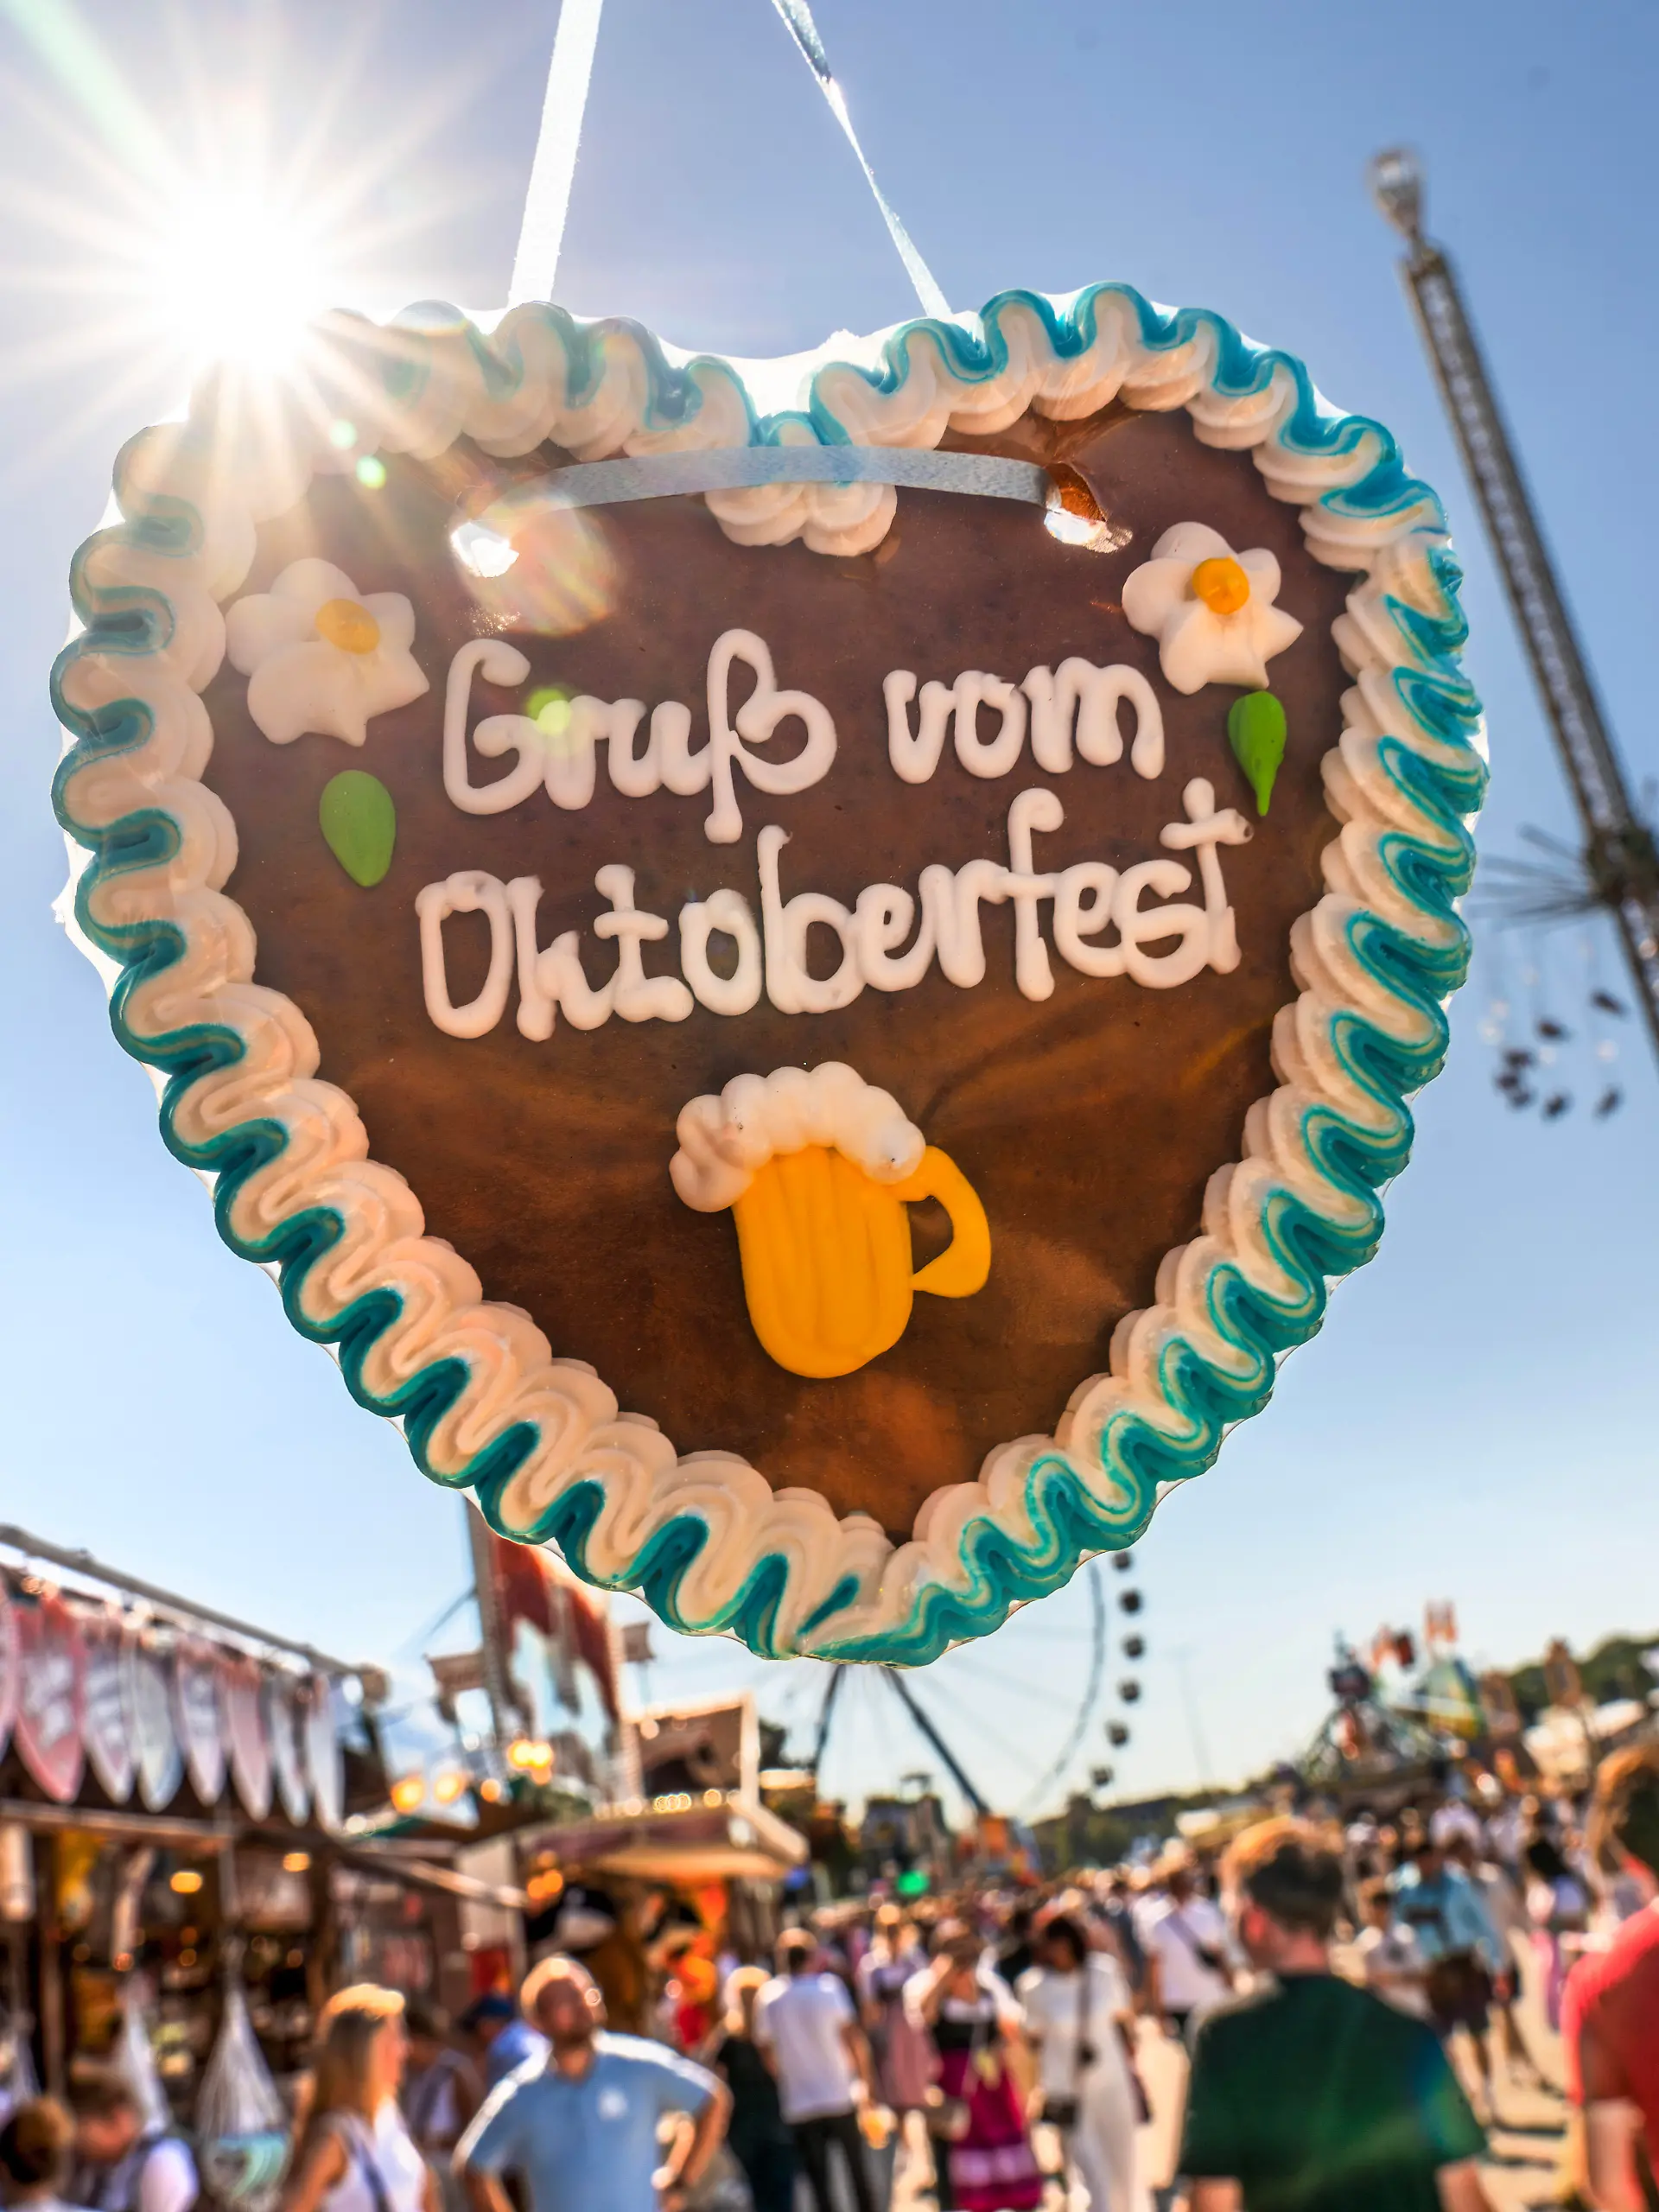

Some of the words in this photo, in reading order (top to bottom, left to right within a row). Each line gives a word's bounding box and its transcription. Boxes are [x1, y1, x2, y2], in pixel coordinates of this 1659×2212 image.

[443, 628, 836, 843] Gruß
[883, 657, 1164, 783] vom
[416, 777, 1254, 1040] Oktoberfest
